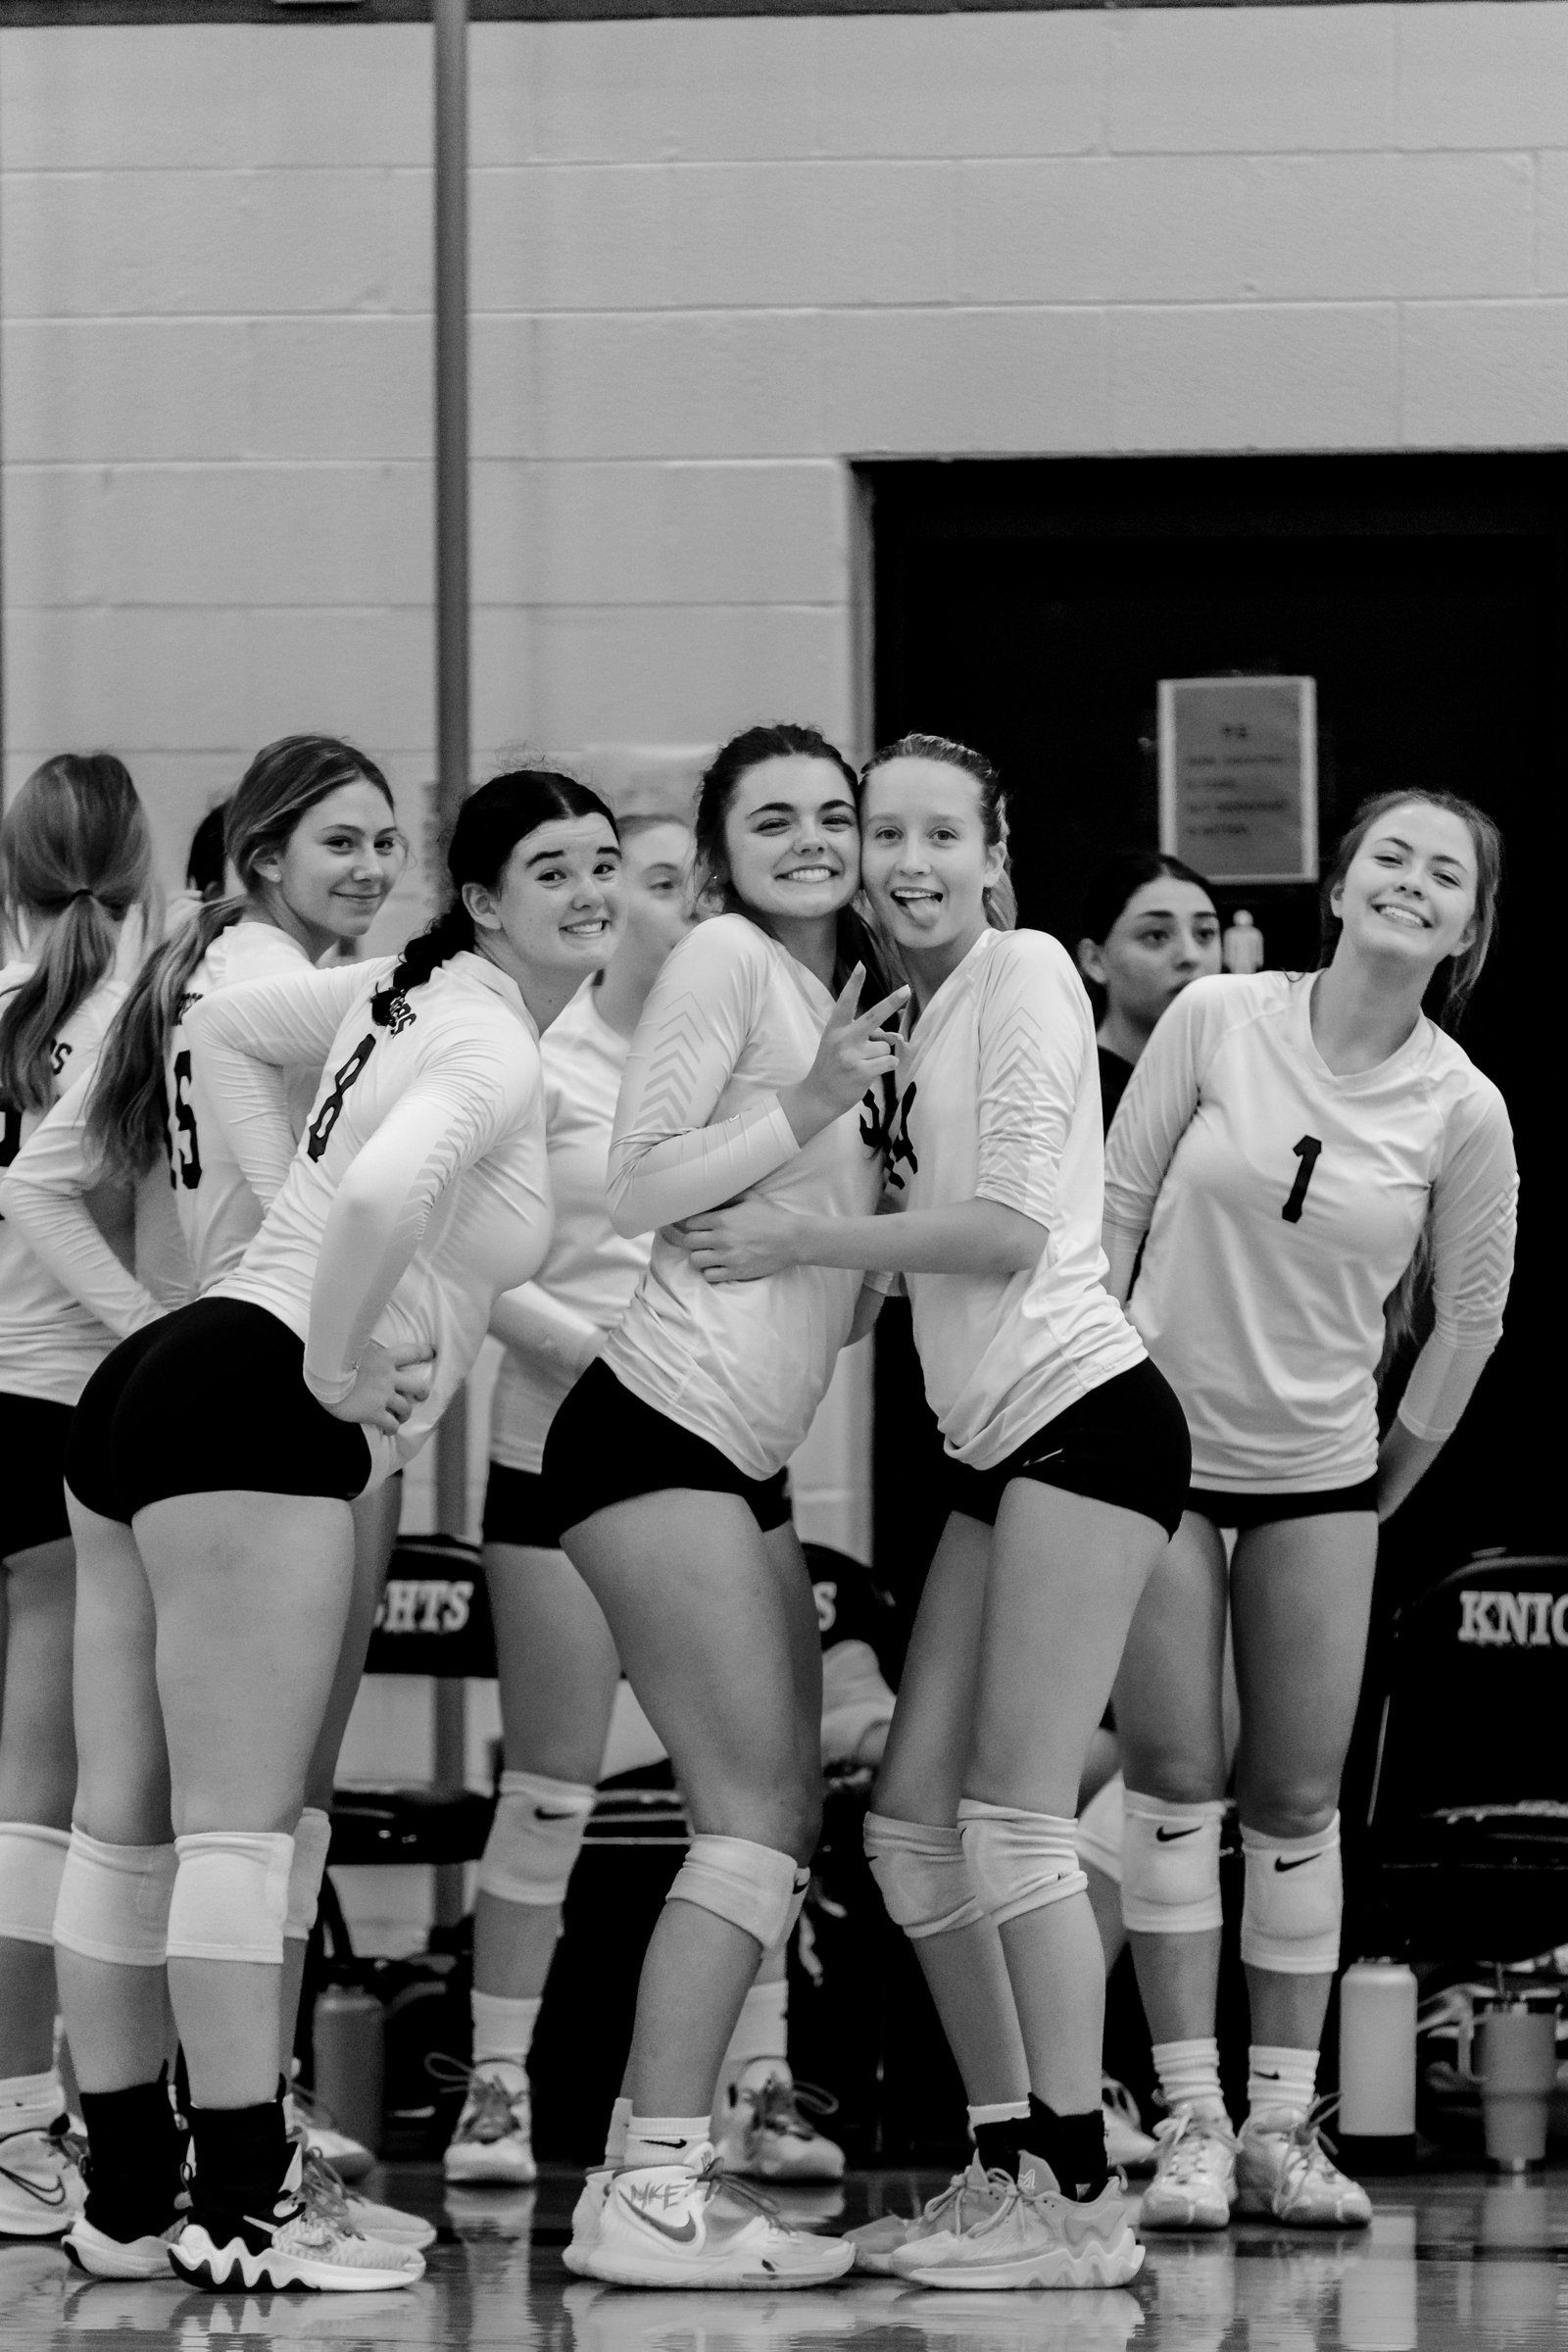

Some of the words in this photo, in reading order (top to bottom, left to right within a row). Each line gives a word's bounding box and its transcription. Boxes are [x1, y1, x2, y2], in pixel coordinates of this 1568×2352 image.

[307, 1033, 376, 1163] 8
[1282, 1134, 1322, 1224] 1
[374, 1580, 474, 1635] HTS
